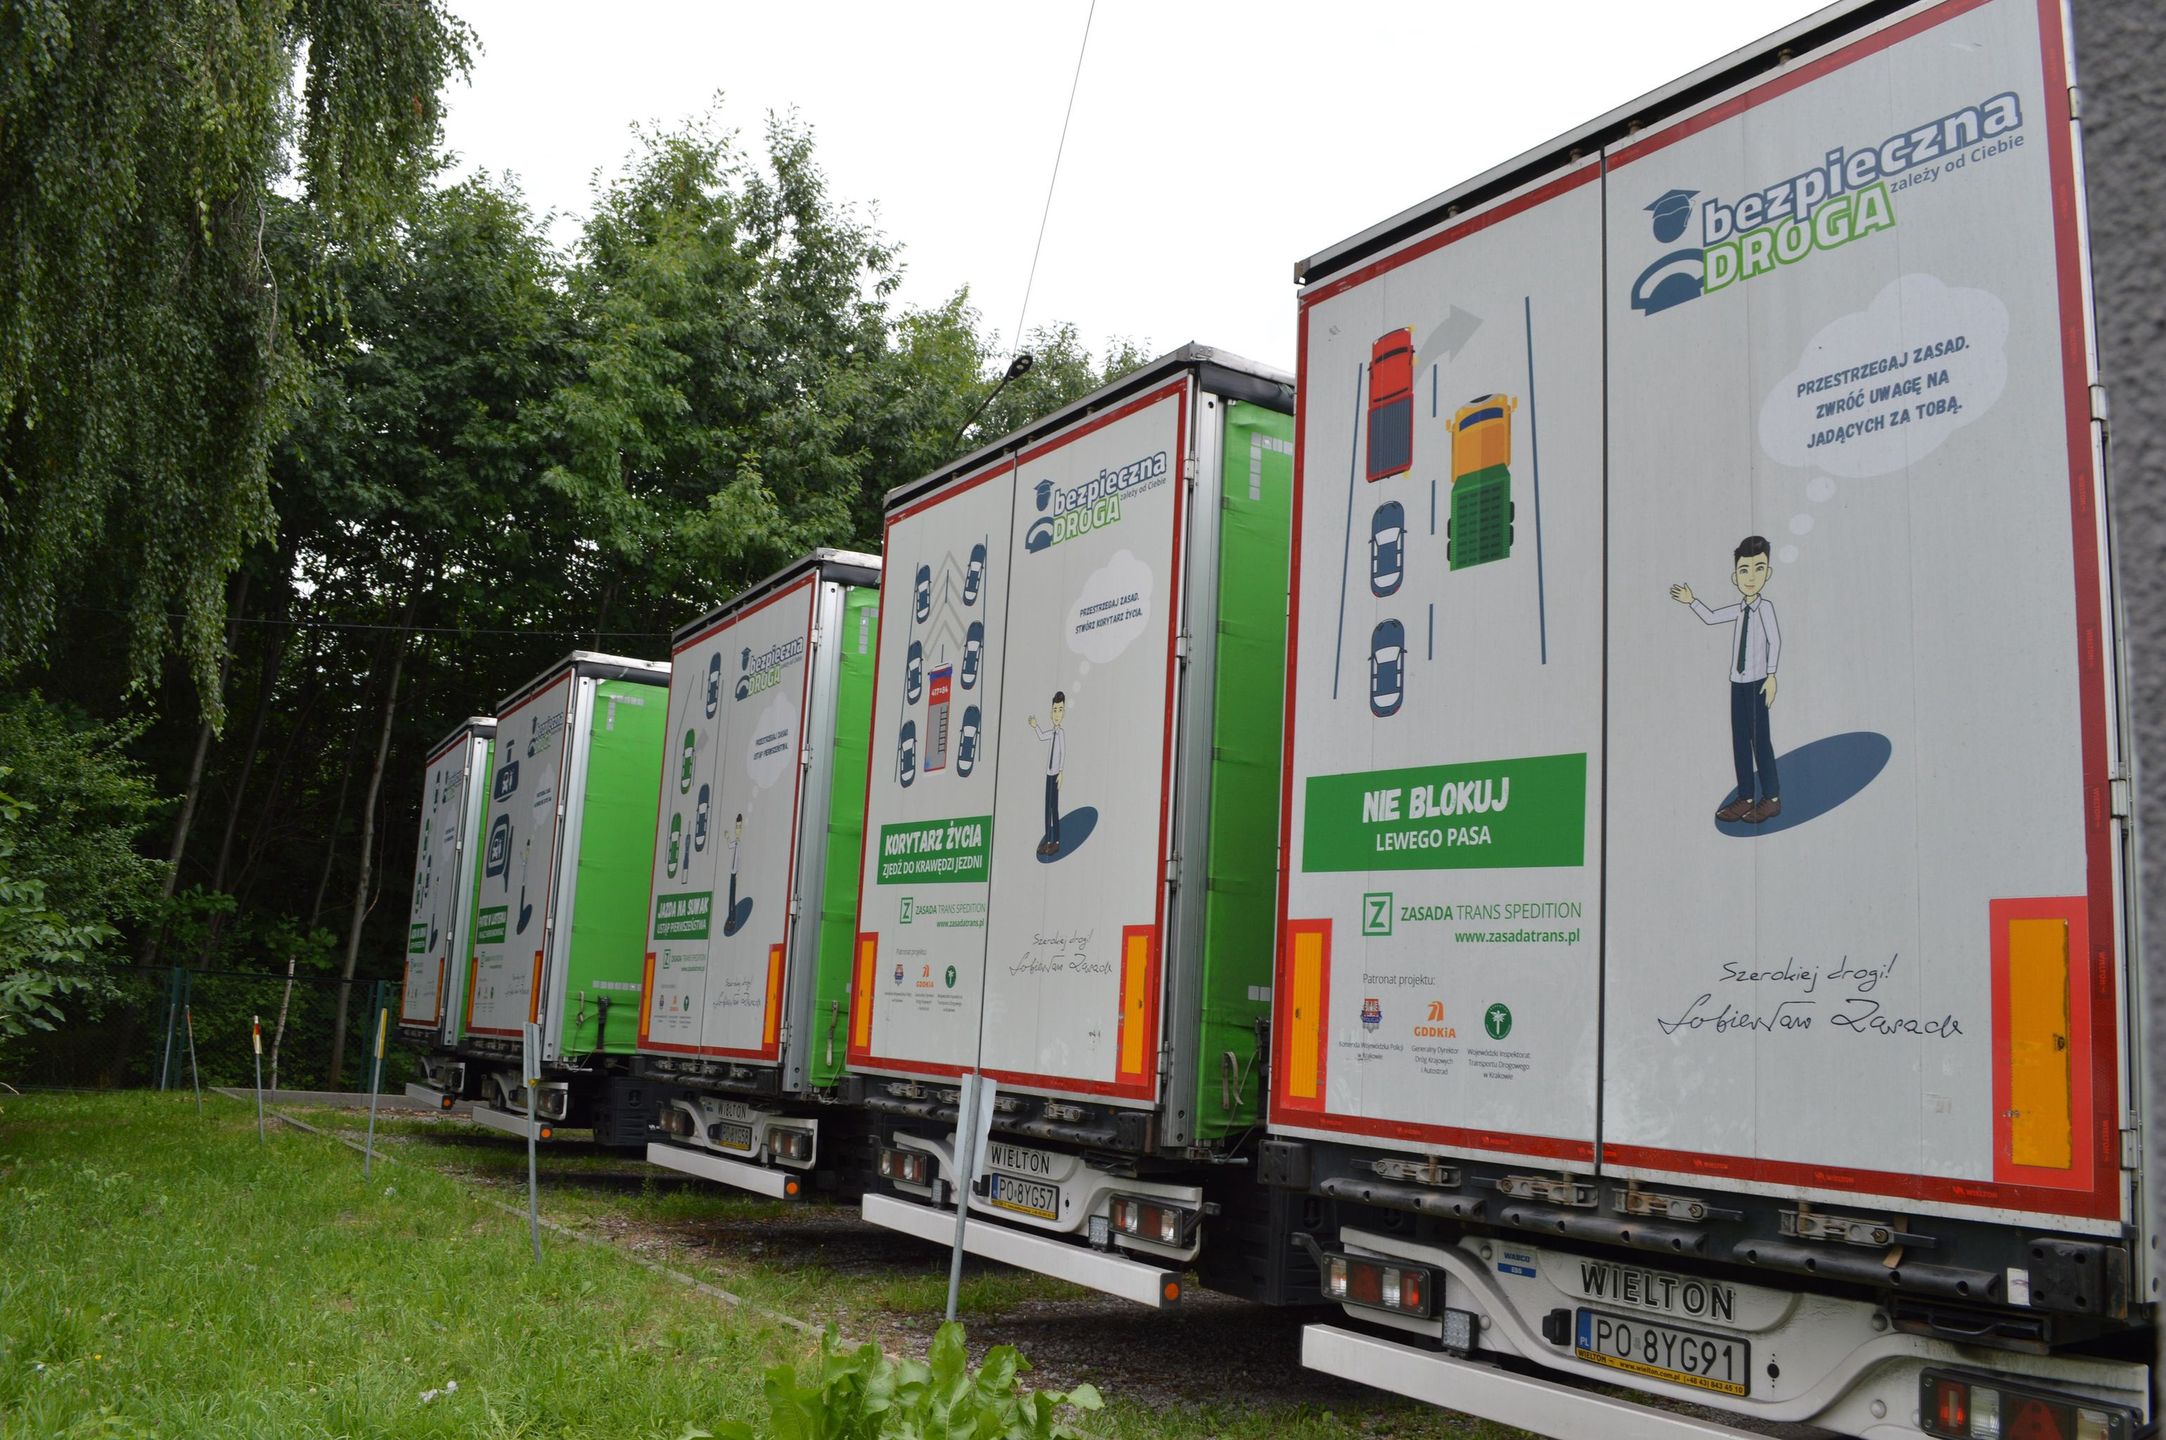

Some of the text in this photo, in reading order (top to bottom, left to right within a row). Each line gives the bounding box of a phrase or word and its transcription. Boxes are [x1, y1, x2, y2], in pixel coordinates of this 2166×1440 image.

[1703, 91, 2023, 246] bezpieczna
[1890, 134, 2025, 194] zależy od Ciebie
[1703, 181, 1895, 294] DROGA
[1797, 335, 1970, 398] PRZESTRZEGAJ ZASAD.
[1816, 369, 1950, 419] ZWRÓĆ UWAGĘ NA
[1807, 396, 1963, 449] JADĄCYCH ZA TOBĄ.
[1054, 451, 1167, 517] bezpieczna
[1052, 492, 1121, 545] DROGA
[750, 636, 803, 676] bezpieczna
[1363, 777, 1509, 823] NIE BLOKUJ
[884, 821, 982, 856] KORYTARZ ŻYCIA
[1376, 826, 1491, 851] LEWEGO PASA
[882, 855, 983, 878] ZJEDŹ DO KRAWĘDZI JEZDNI
[915, 905, 937, 915] ZASADA
[1401, 905, 1453, 921] ZASADA
[1457, 904, 1501, 920] TRANS
[1504, 902, 1582, 920] SPEDITION
[1455, 928, 1580, 946] www.zasadatrans.pl
[1363, 973, 1435, 987] Patronat projektu:
[1719, 953, 1898, 993] Szerokiej drogi!
[1414, 1027, 1456, 1038] GDDKiA
[992, 1145, 1050, 1174] WIELTON
[1000, 1179, 1013, 1201] PO
[1017, 1183, 1053, 1210] 8YG57
[1504, 1252, 1530, 1264] WABCO
[1580, 1263, 1734, 1321] WIELTON
[1580, 1336, 1590, 1347] PL
[1597, 1319, 1732, 1381] PO 8YG91
[1577, 1349, 1606, 1363] WIELTON
[1619, 1361, 1681, 1380] www.wielton.com.pl
[1711, 1381, 1723, 1389] 843
[1724, 1383, 1733, 1391] 45
[1735, 1385, 1743, 1393] 10
